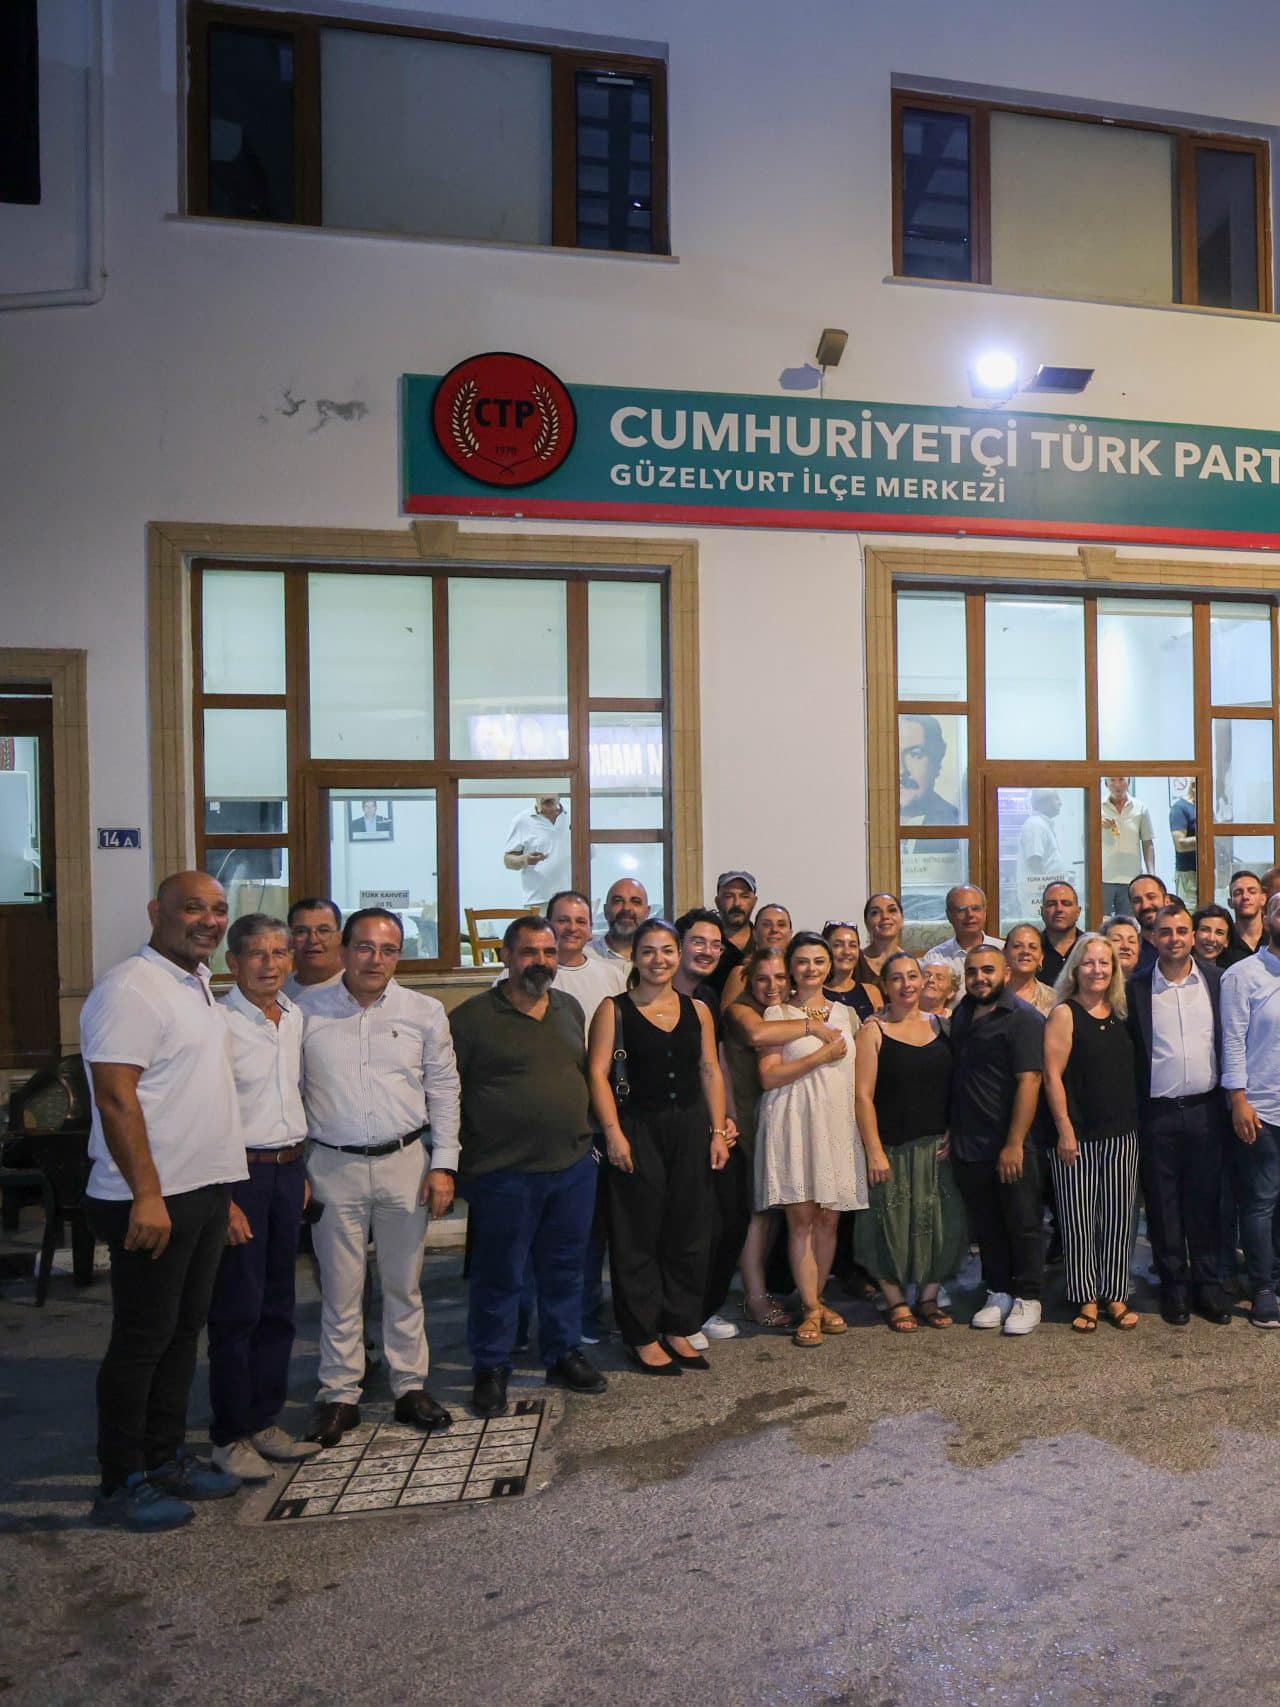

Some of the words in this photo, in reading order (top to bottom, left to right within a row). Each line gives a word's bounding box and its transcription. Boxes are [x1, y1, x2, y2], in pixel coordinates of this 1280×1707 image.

[475, 398, 535, 428] CTP
[610, 406, 1018, 477] CUMHURİYETÇİ
[1031, 423, 1162, 477] TÜRK
[610, 459, 794, 493] GÜZELYURT
[803, 467, 867, 501] İLÇE
[876, 476, 1006, 504] MERKEZİ
[103, 831, 120, 847] 14
[123, 836, 134, 848] A
